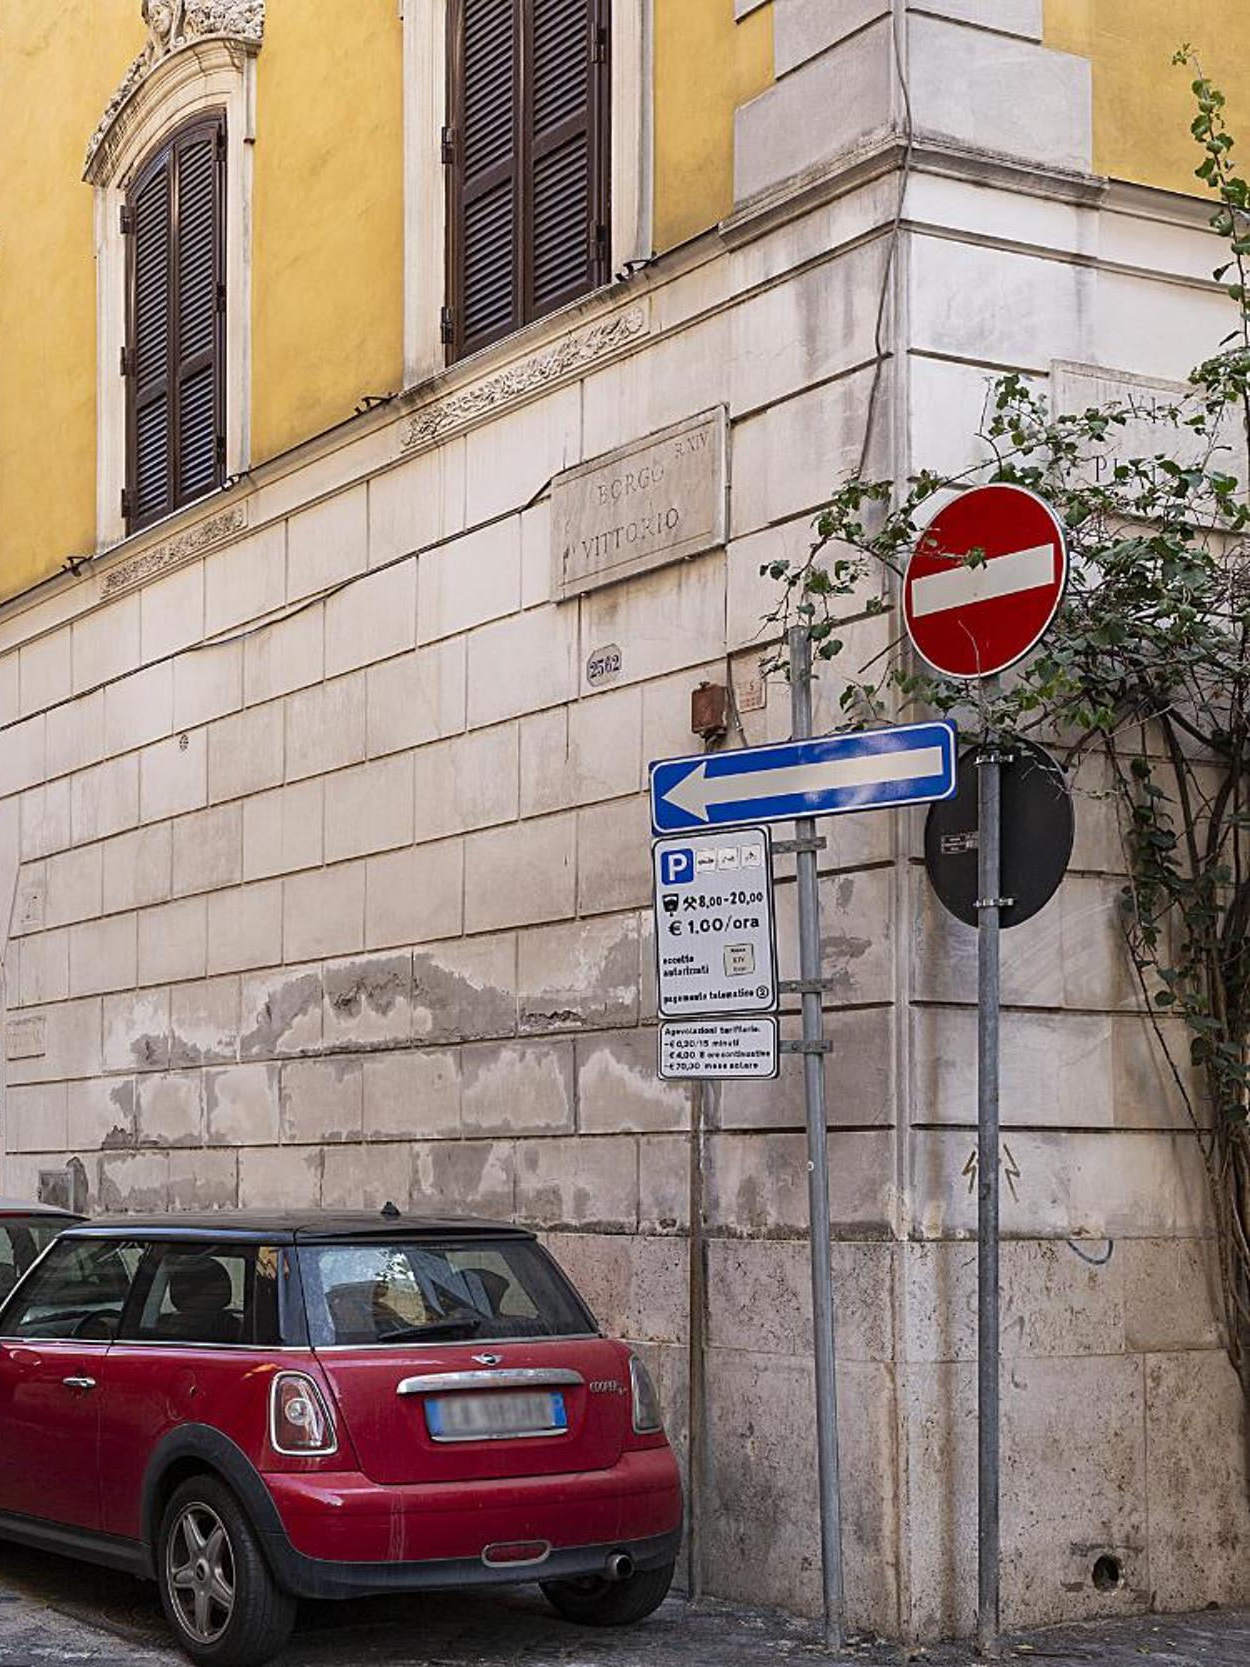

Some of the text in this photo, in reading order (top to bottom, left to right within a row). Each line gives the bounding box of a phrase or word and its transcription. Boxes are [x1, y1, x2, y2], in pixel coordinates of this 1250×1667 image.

[598, 464, 664, 506] BORGO
[581, 508, 679, 559] VITTORIO
[589, 655, 619, 679] 2562
[668, 853, 688, 882] P
